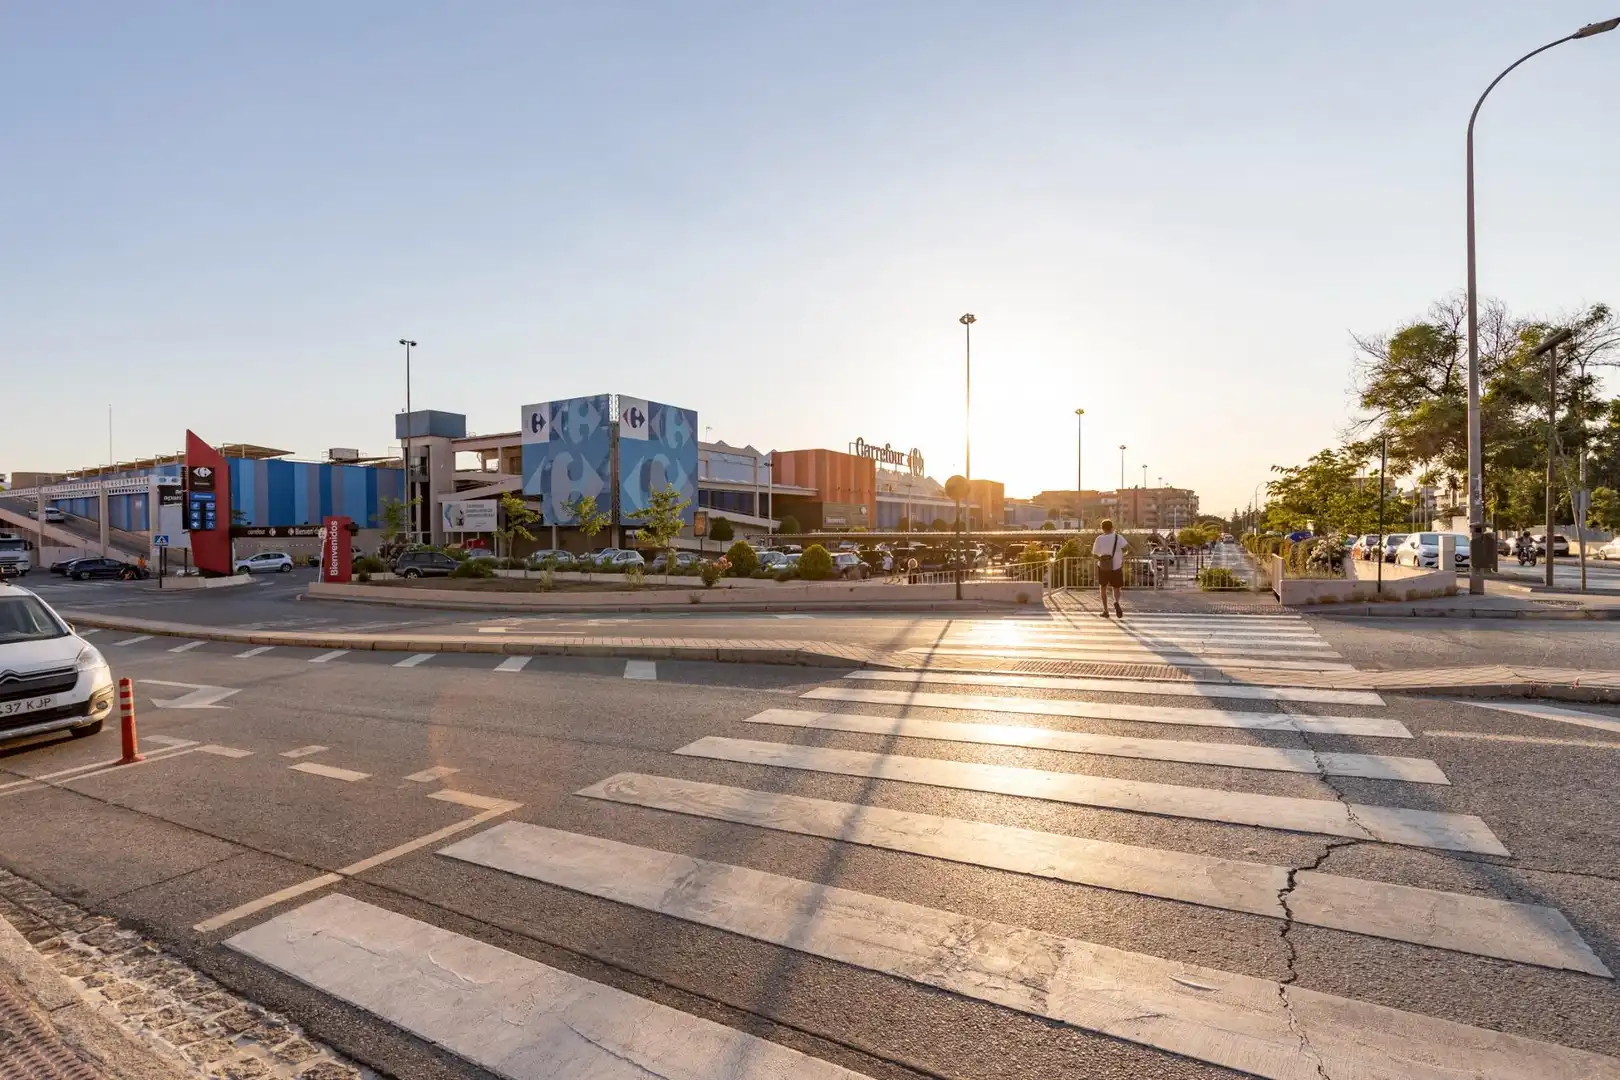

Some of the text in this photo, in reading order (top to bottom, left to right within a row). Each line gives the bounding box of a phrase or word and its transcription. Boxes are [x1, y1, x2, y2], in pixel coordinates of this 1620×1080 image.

[856, 436, 905, 466] Carrefour
[330, 520, 338, 576] Bienvenidos
[26, 697, 51, 710] KJP
